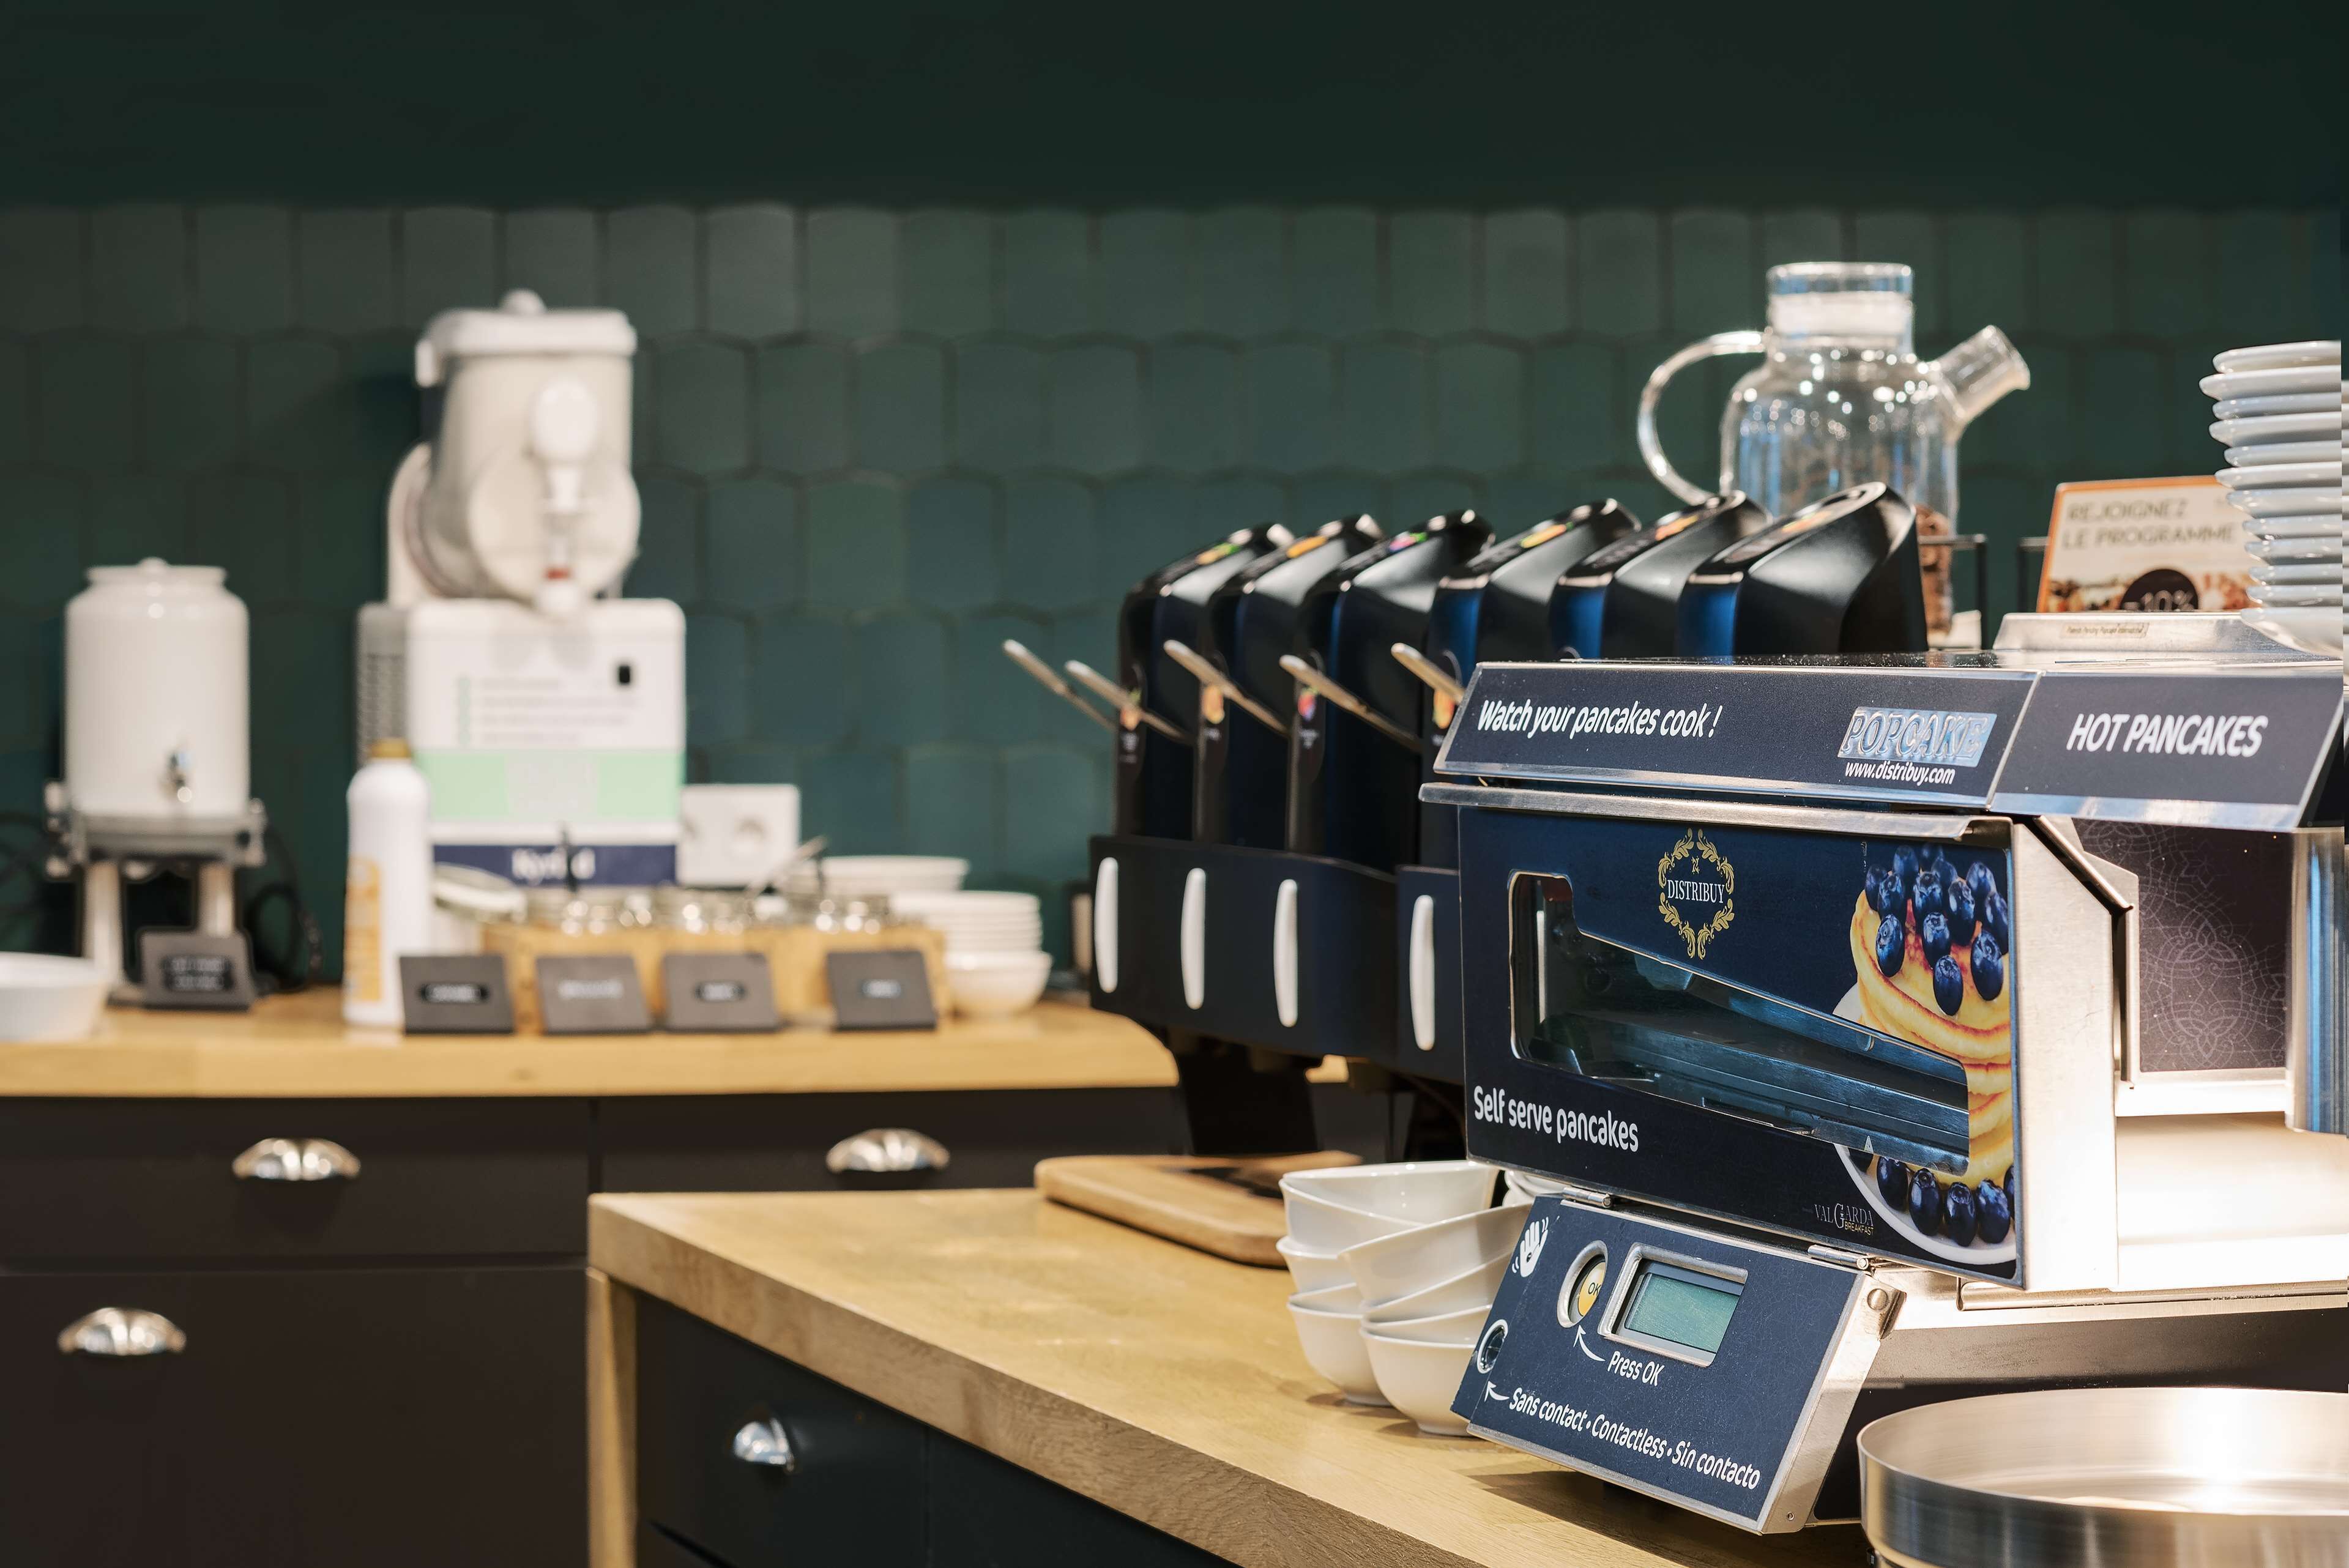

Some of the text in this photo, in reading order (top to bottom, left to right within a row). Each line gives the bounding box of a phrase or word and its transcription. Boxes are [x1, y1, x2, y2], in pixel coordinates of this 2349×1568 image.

[2068, 499, 2188, 521] REJOIGNEZ
[2062, 523, 2235, 549] LE PROGRAMME
[1477, 699, 1532, 731] Watch
[1528, 707, 1576, 738] your
[1569, 700, 1661, 739] pancakes
[1840, 711, 1988, 758] POPCAKE
[2066, 713, 2268, 757] HOT PANCAKES
[1845, 761, 1956, 786] www.distribuy.com
[1667, 880, 1725, 903] DISTRIBUY
[1474, 1085, 1639, 1152] Self serve pancakes
[1844, 1221, 1874, 1236] BREAKFAST
[1588, 1282, 1601, 1296] OK
[1607, 1351, 1664, 1386] Press OK
[1509, 1387, 1761, 1490] Sans contact Contactless Sin contacto
